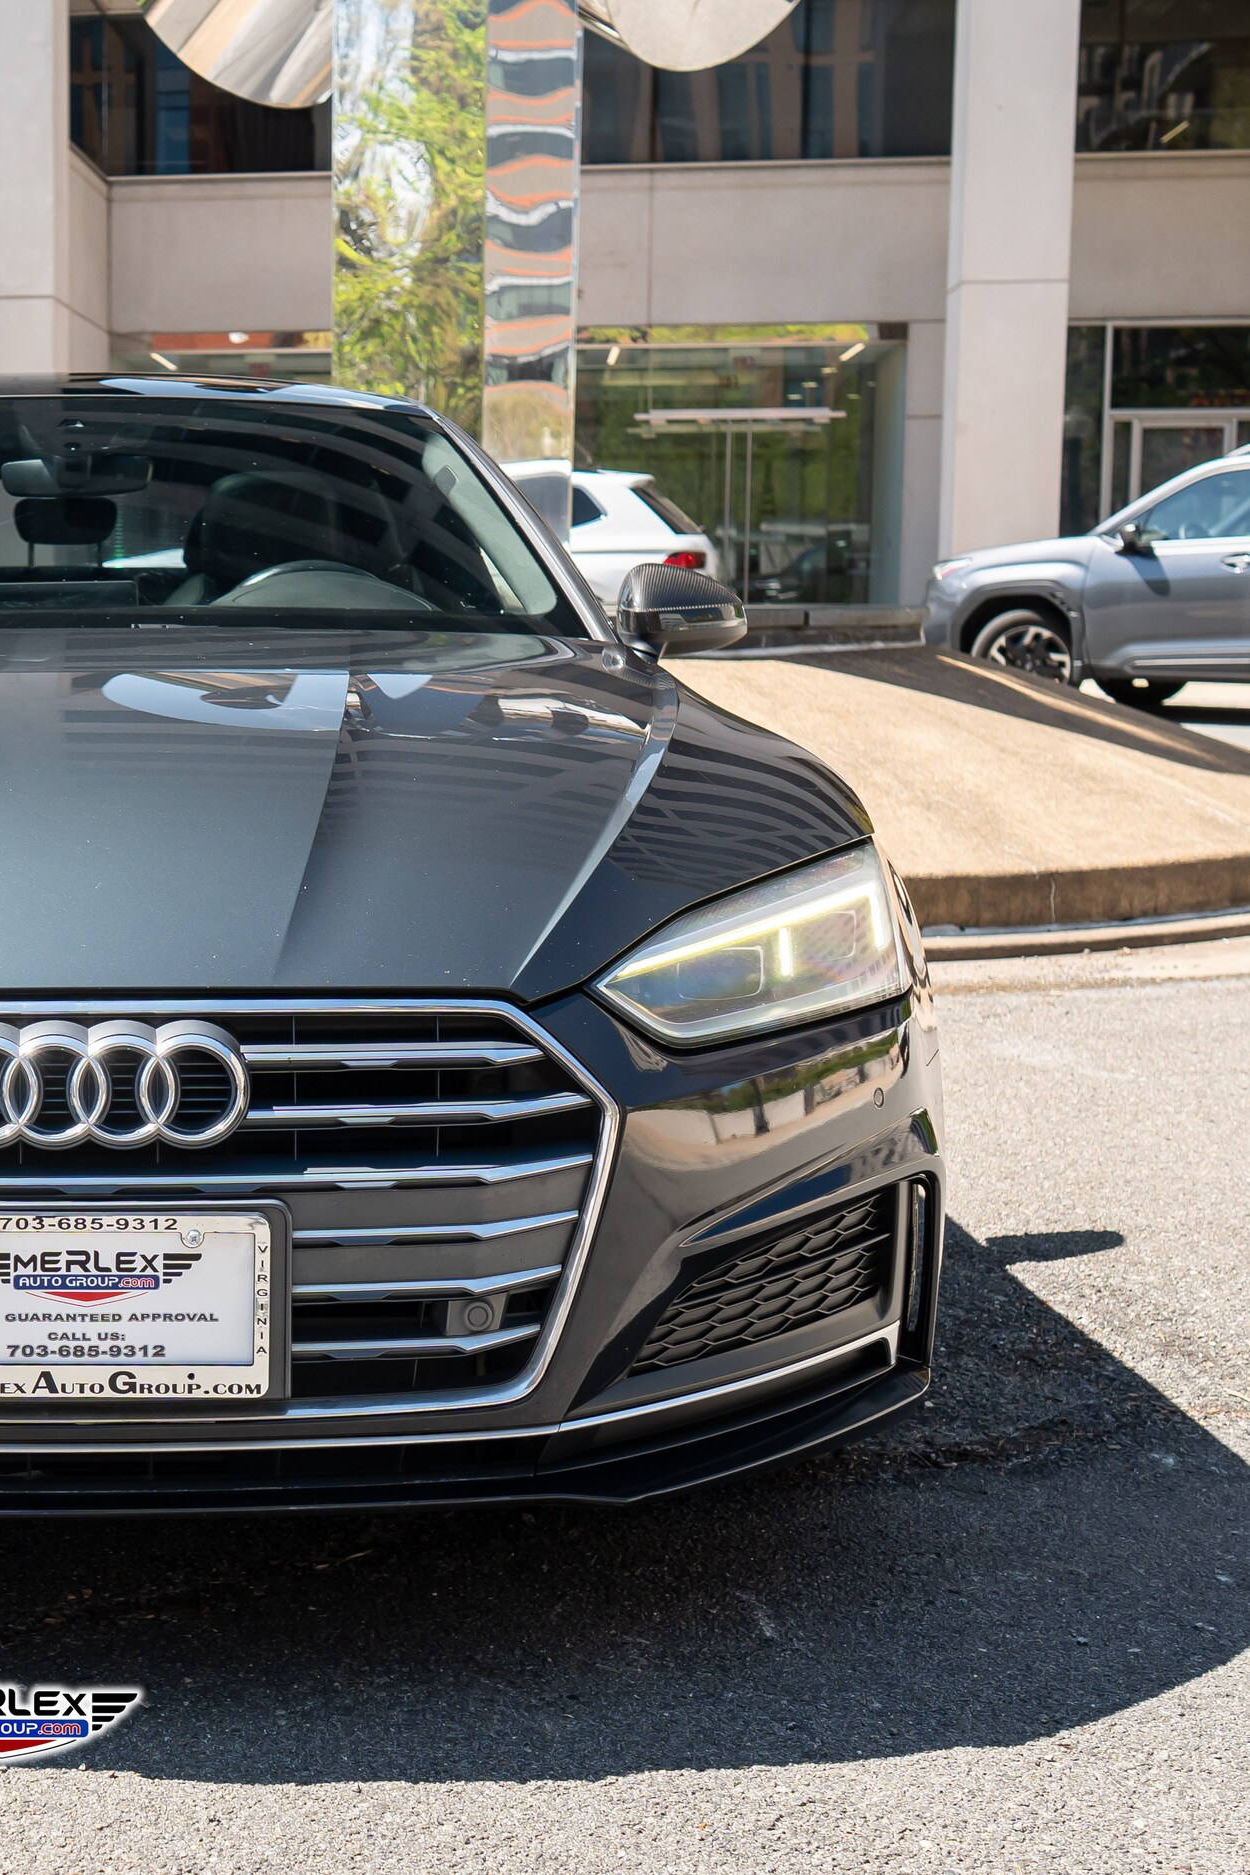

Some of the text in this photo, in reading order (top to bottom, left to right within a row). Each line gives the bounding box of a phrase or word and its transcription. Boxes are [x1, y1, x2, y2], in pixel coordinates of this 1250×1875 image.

[0, 1217, 178, 1231] 703-685-9312
[14, 1250, 160, 1273] MERLEX
[19, 1276, 61, 1287] AUTO
[257, 1246, 268, 1354] VIRGINIA
[5, 1313, 122, 1322] GUARANTEED
[128, 1313, 218, 1322] APPROVAL
[48, 1332, 125, 1341] CALL US:
[7, 1345, 165, 1358] 703-685-9312
